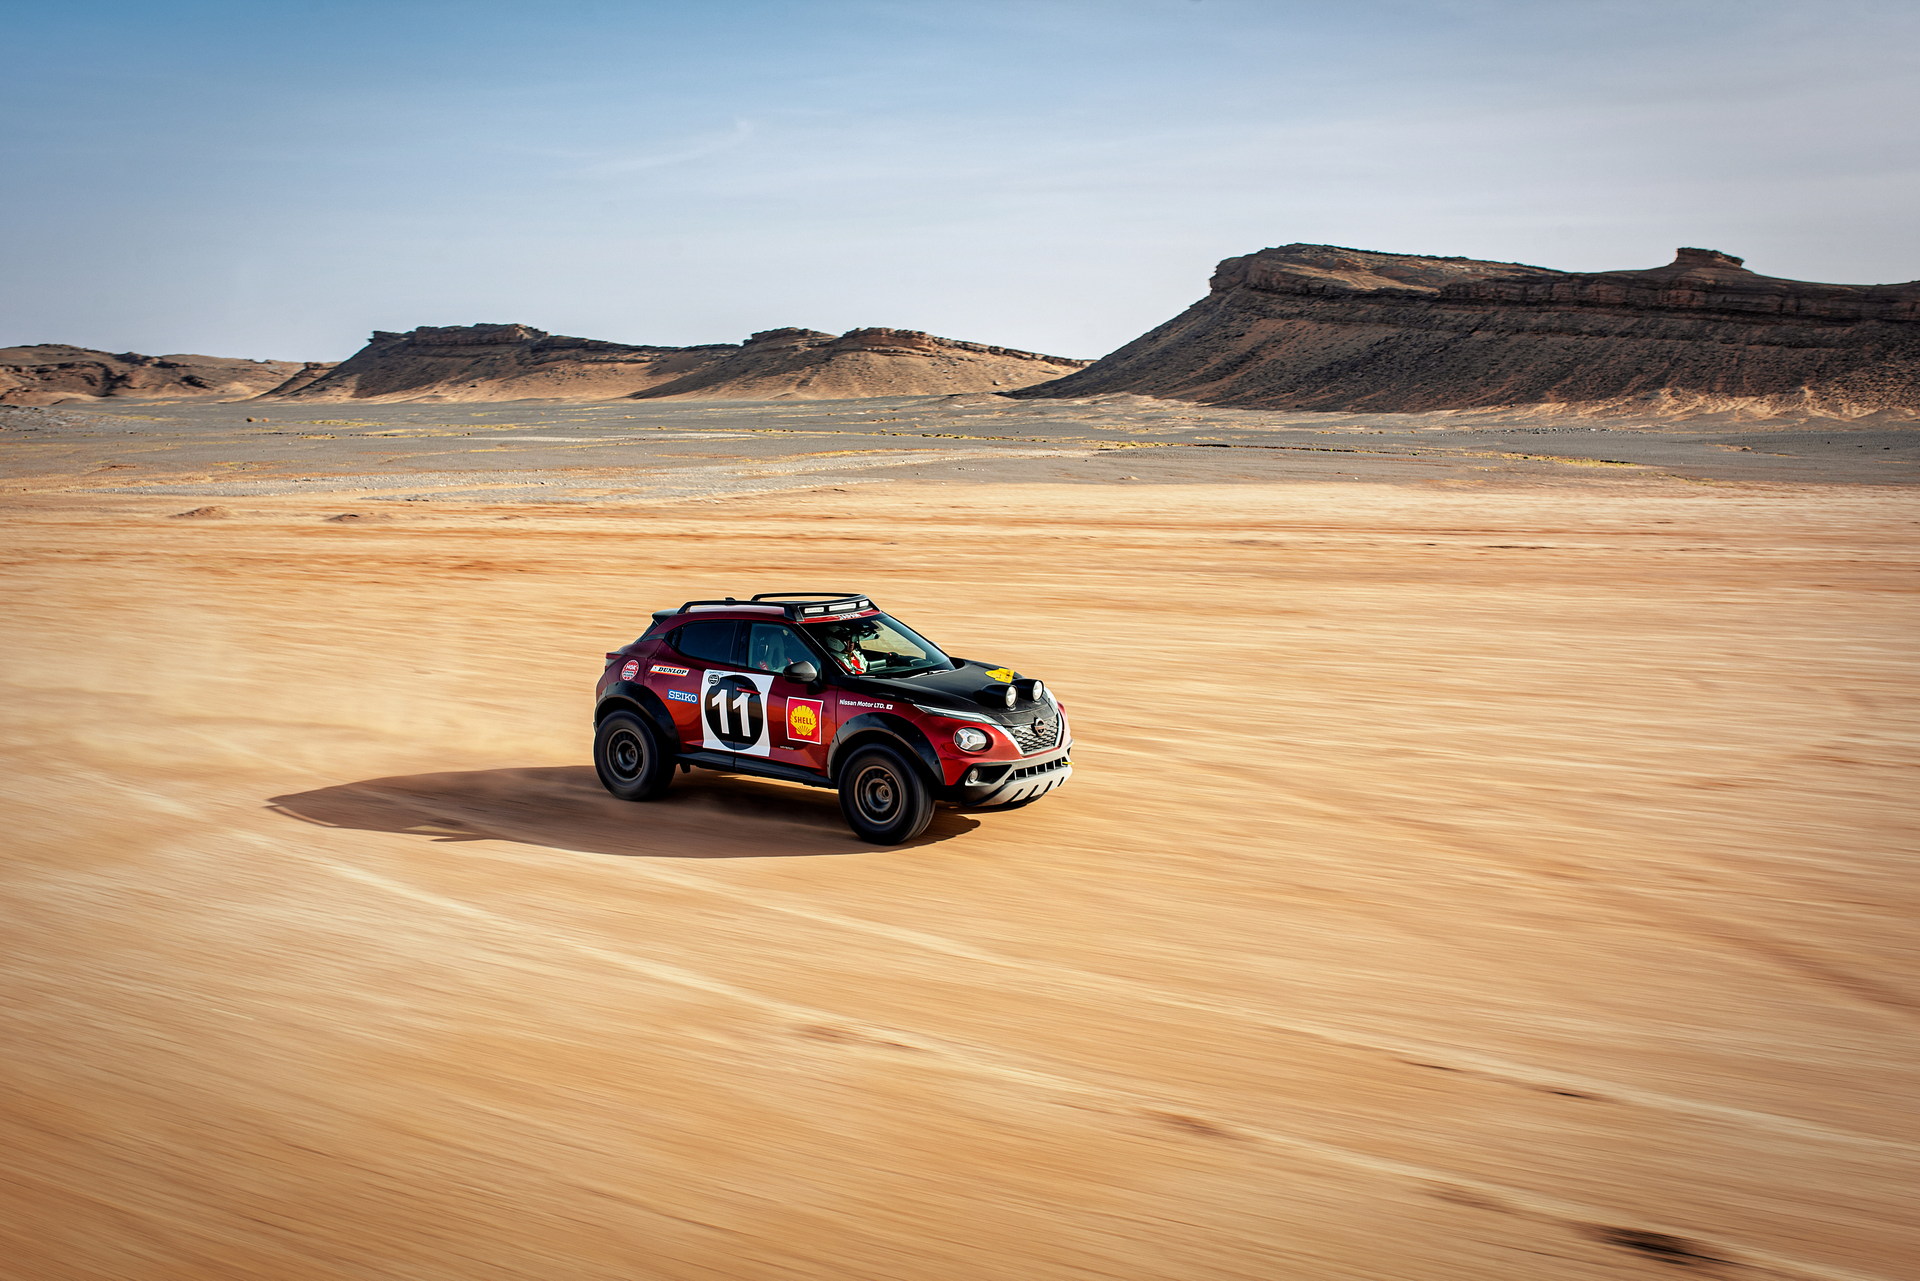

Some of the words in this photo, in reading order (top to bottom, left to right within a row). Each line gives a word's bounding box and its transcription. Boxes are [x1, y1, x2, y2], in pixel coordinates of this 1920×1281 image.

[658, 667, 687, 675] DUNLOP
[668, 691, 697, 703] SEIKO
[711, 688, 751, 738] 11
[794, 716, 813, 725] SHELL
